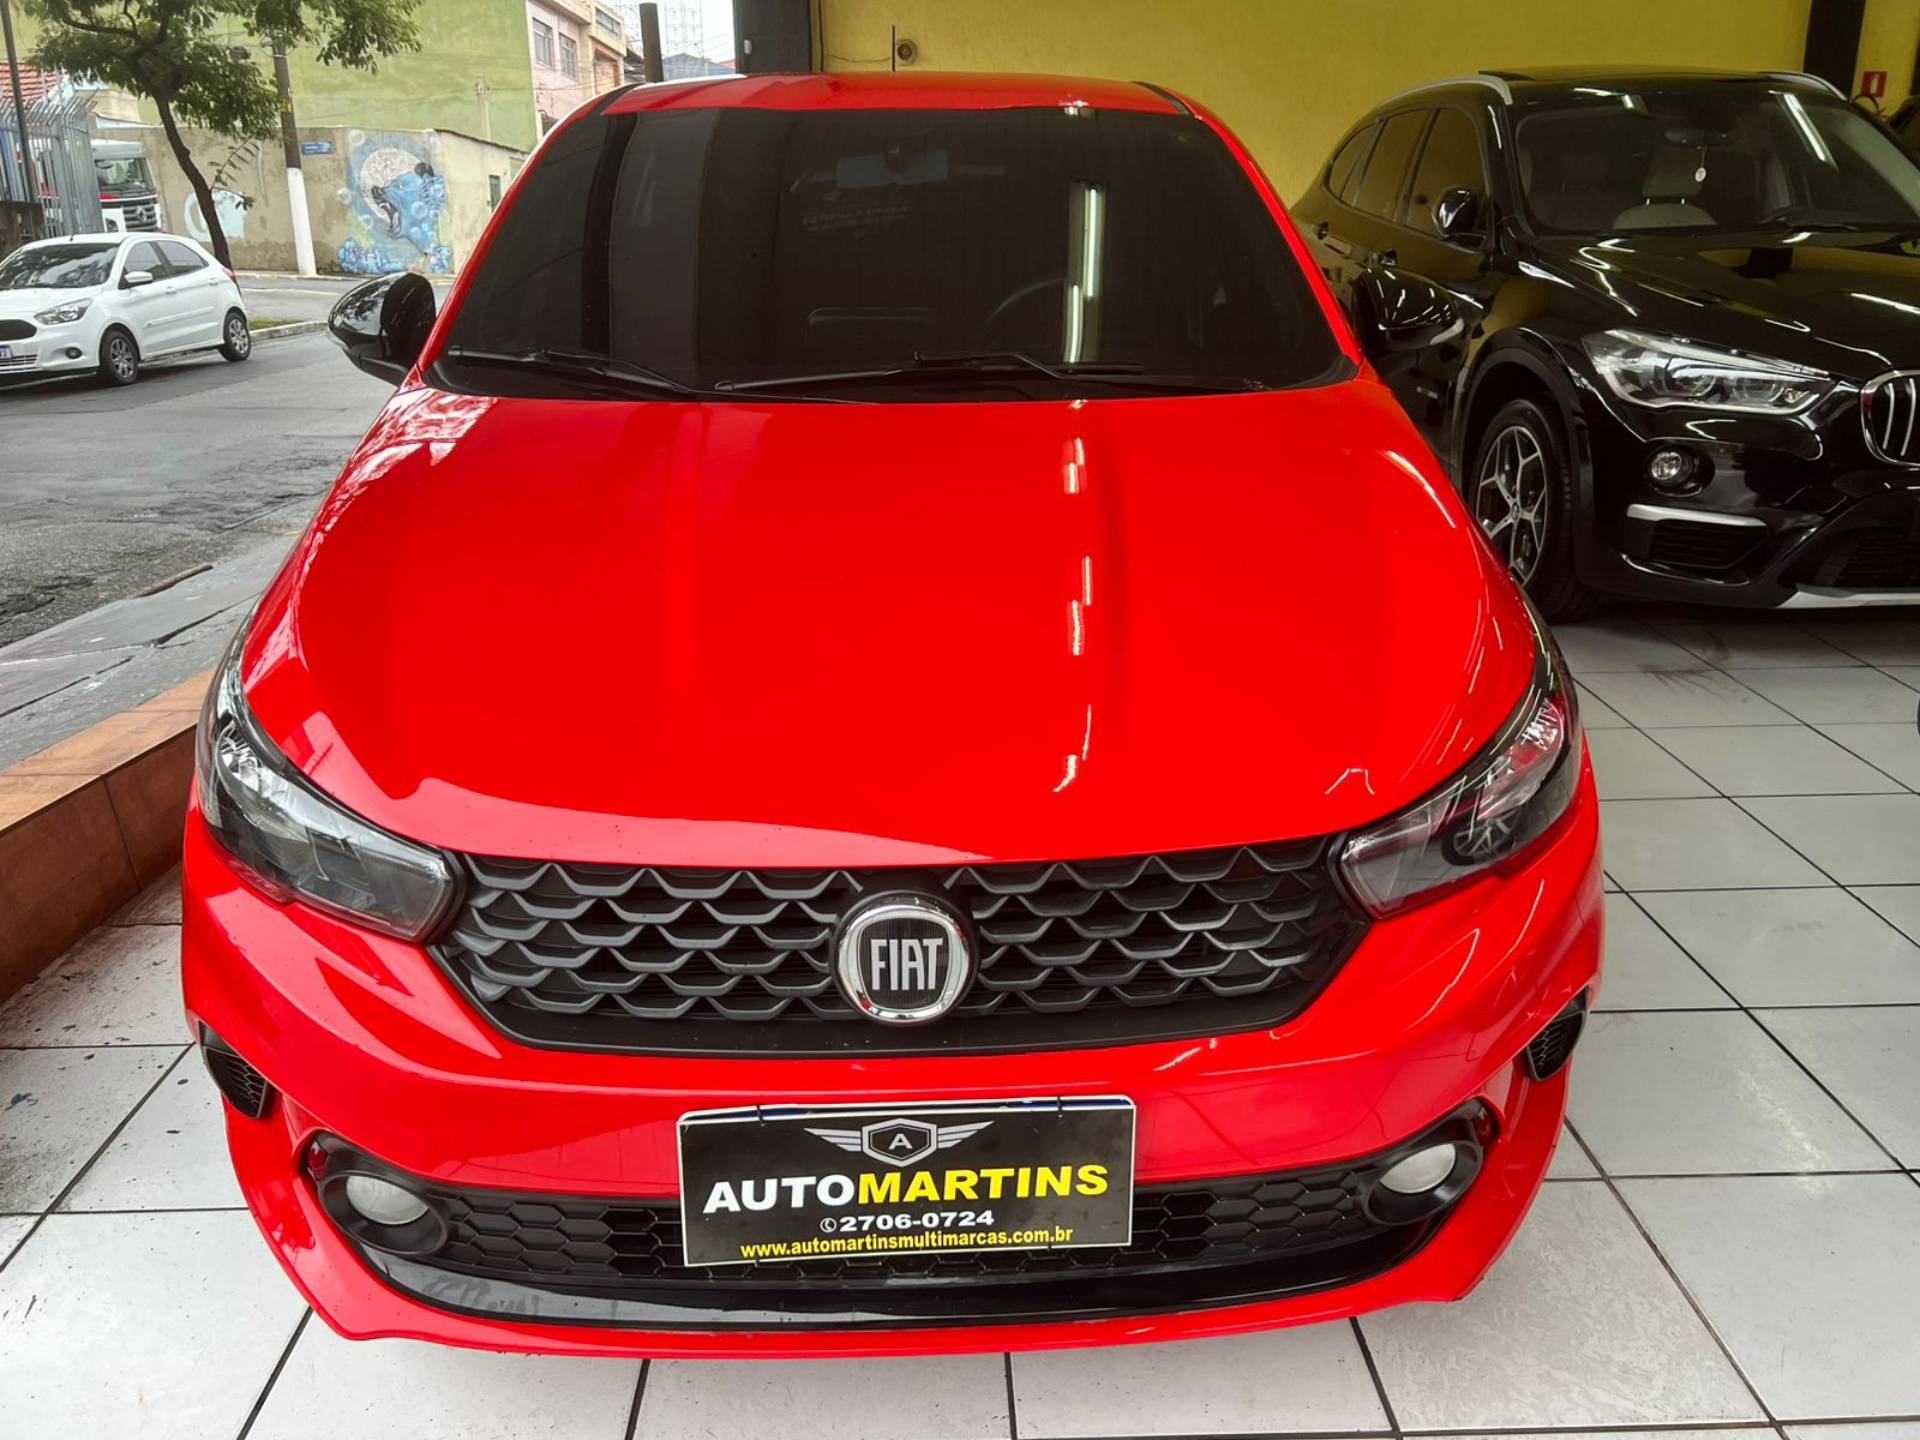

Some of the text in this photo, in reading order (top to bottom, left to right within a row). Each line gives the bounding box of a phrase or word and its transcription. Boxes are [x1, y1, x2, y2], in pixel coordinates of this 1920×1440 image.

[870, 937, 944, 991] FIAT
[888, 1133, 913, 1150] A
[703, 1165, 1109, 1213] AUTOMARTINS
[839, 1210, 995, 1232] 2706-0724
[740, 1226, 1074, 1259] www.automartinsmultimarcas.com.br
